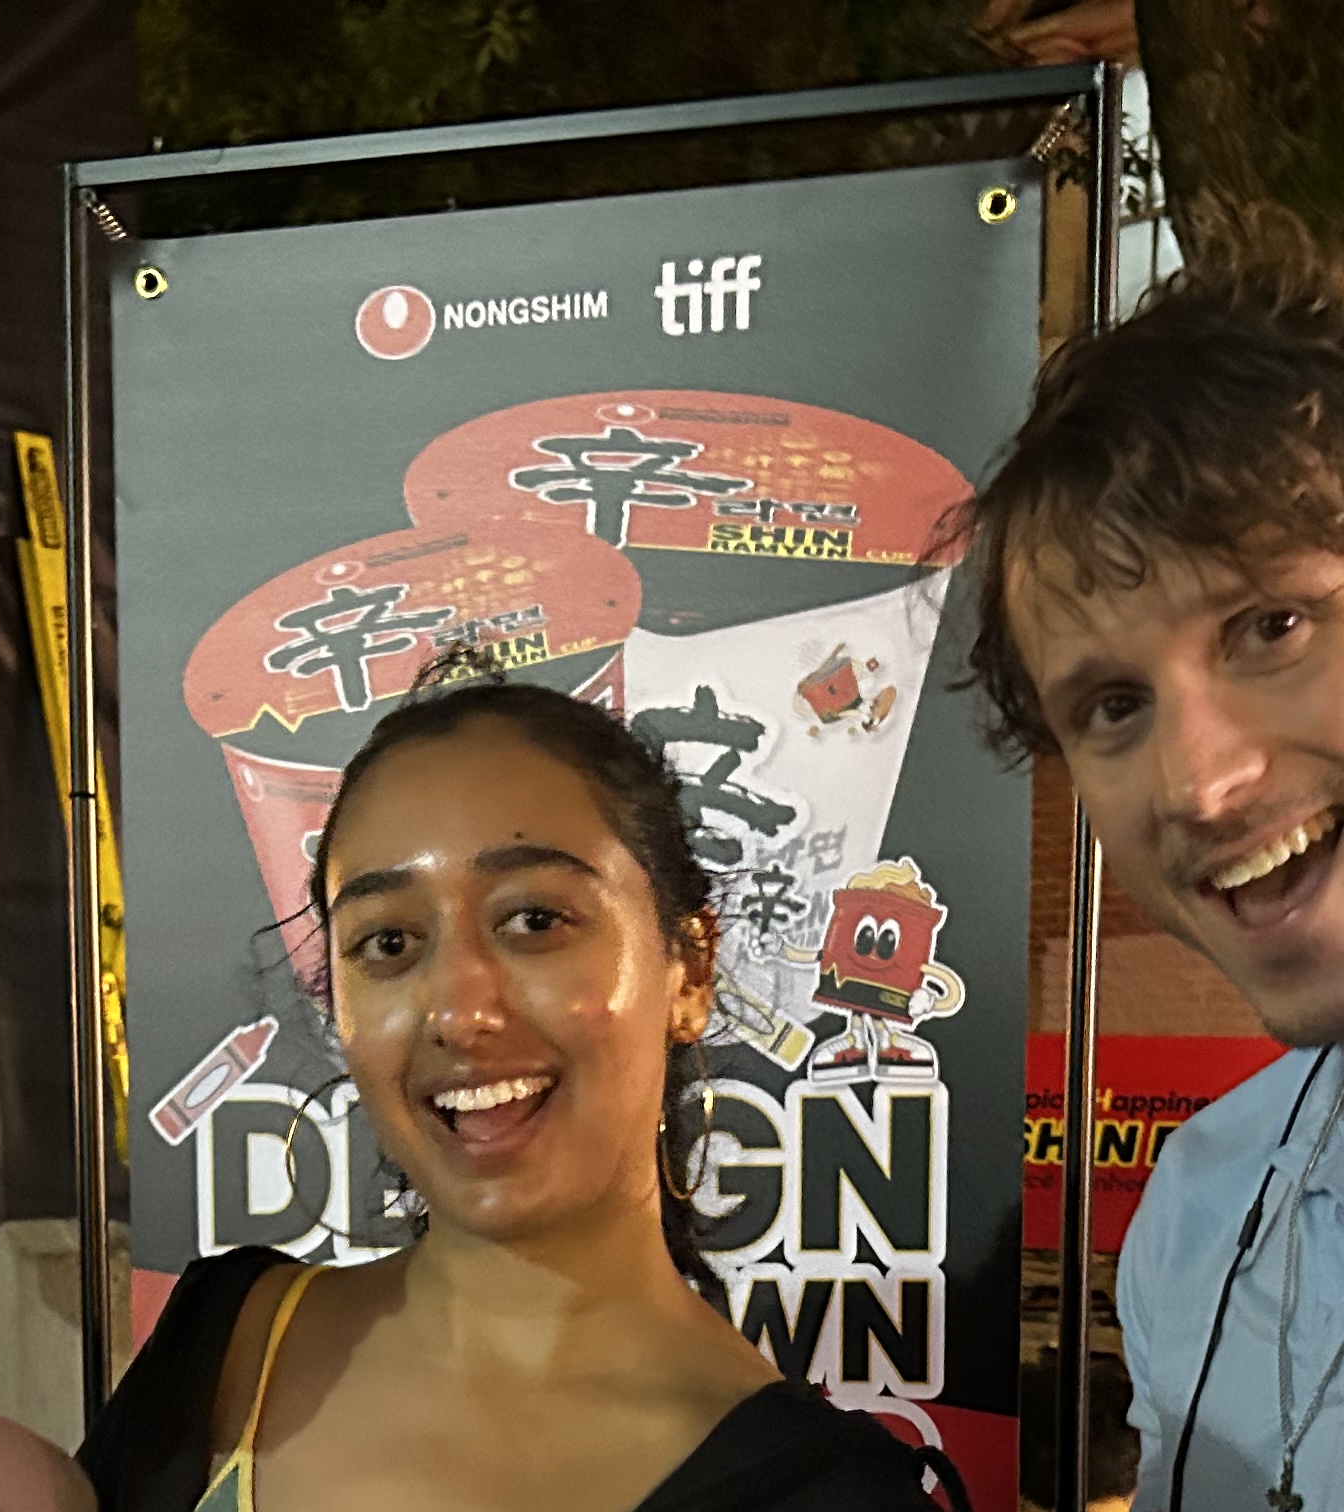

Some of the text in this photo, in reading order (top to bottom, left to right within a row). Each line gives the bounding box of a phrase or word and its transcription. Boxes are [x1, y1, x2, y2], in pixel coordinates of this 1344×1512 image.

[443, 290, 609, 331] NONGSHIM
[653, 254, 762, 336] tiff
[511, 426, 755, 549] 辛
[710, 540, 848, 560] RAMYUN
[711, 523, 848, 547] SHIN
[262, 583, 456, 713] 辛
[1095, 1086, 1213, 1118] Happine
[198, 1080, 948, 1260] DEGN
[724, 1265, 946, 1399] WN
